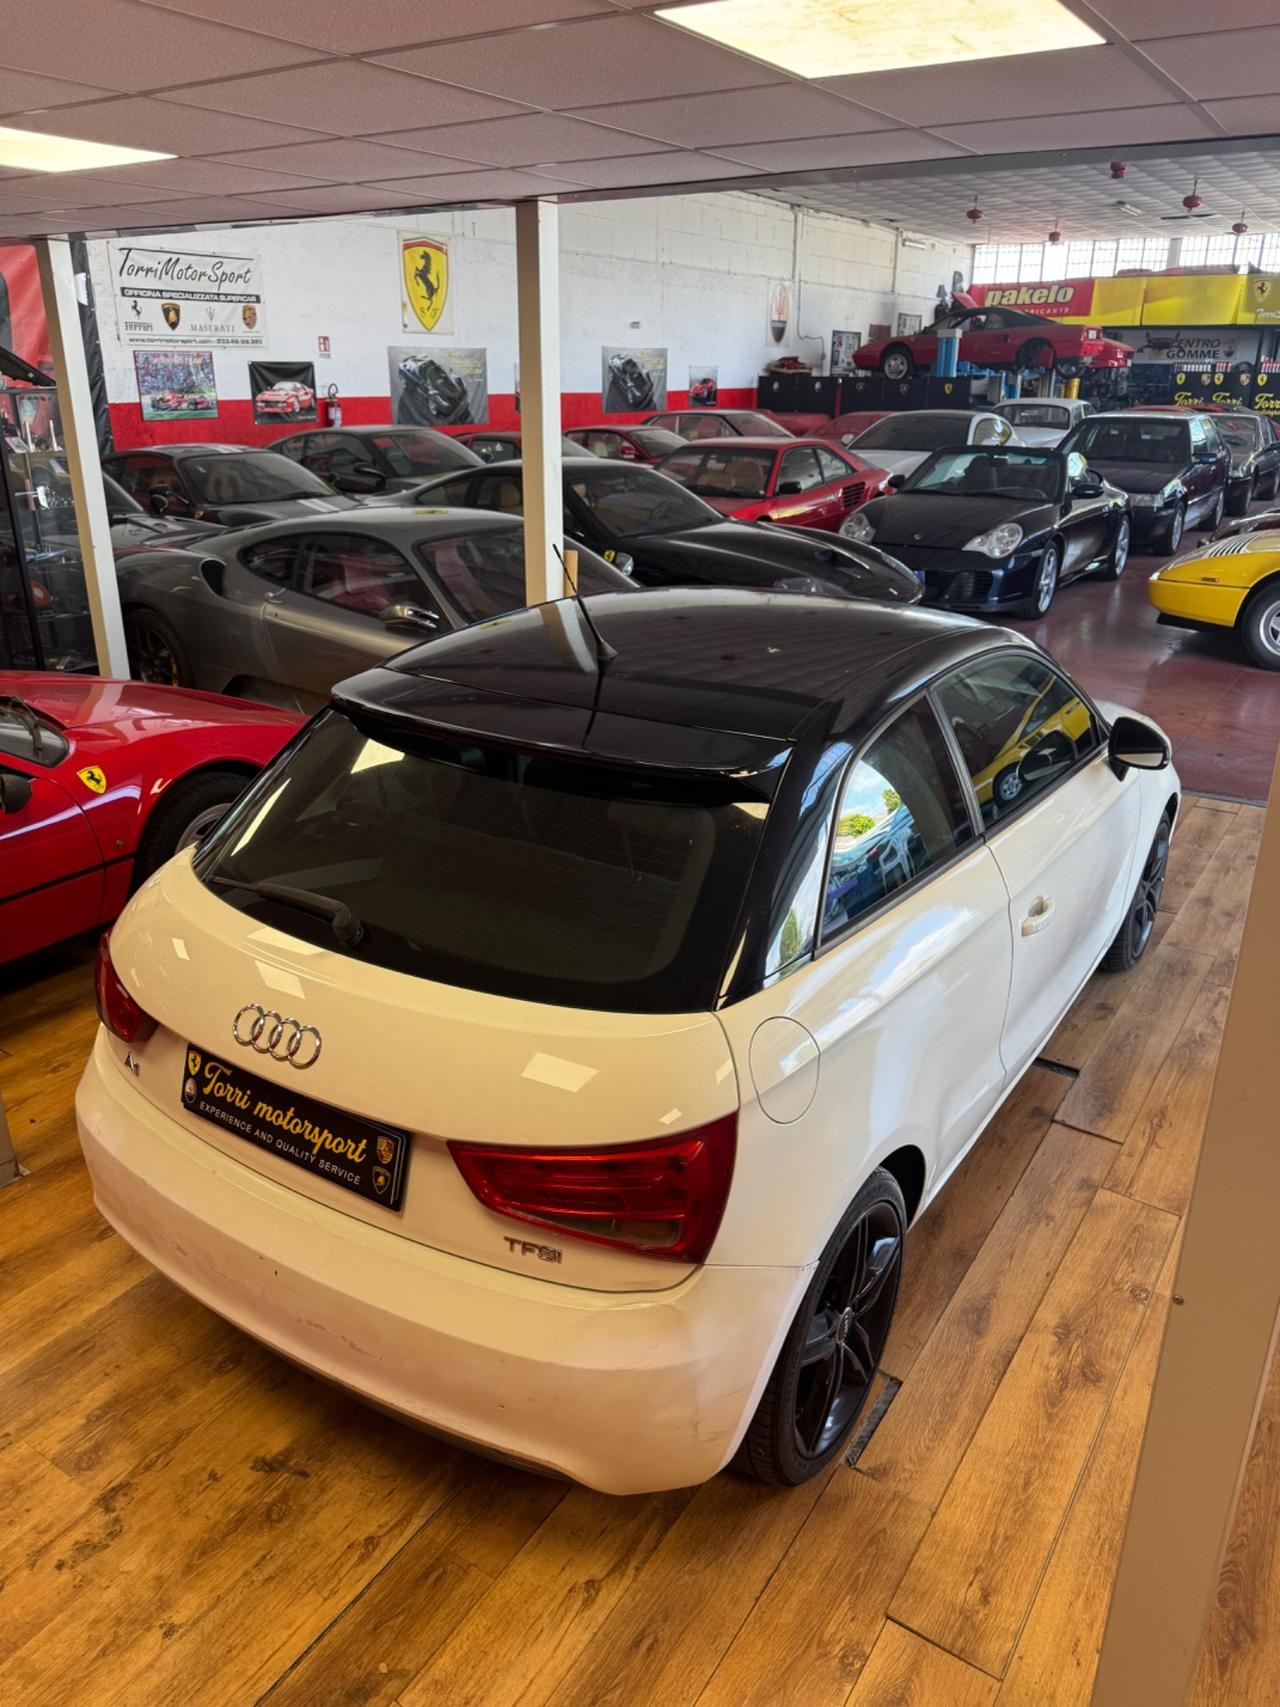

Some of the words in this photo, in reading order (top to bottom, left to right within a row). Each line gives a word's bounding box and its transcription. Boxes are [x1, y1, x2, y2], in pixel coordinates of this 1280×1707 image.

[124, 289, 161, 299] OFFICINA
[162, 291, 218, 301] SPECIALIZZATA
[219, 295, 257, 303] SUPERCAR
[984, 285, 1074, 307] pakelo
[190, 324, 235, 333] MASERATI
[1166, 349, 1220, 359] GOMME
[1254, 392, 1280, 409] Torr
[202, 1061, 251, 1110] Torri
[253, 1100, 367, 1163] motorsport
[199, 1100, 253, 1134] EXPERIENCE
[254, 1127, 274, 1145] AND
[275, 1138, 316, 1166] QUALITY
[318, 1157, 362, 1186] SERVICE
[504, 1236, 562, 1264] TFSI
